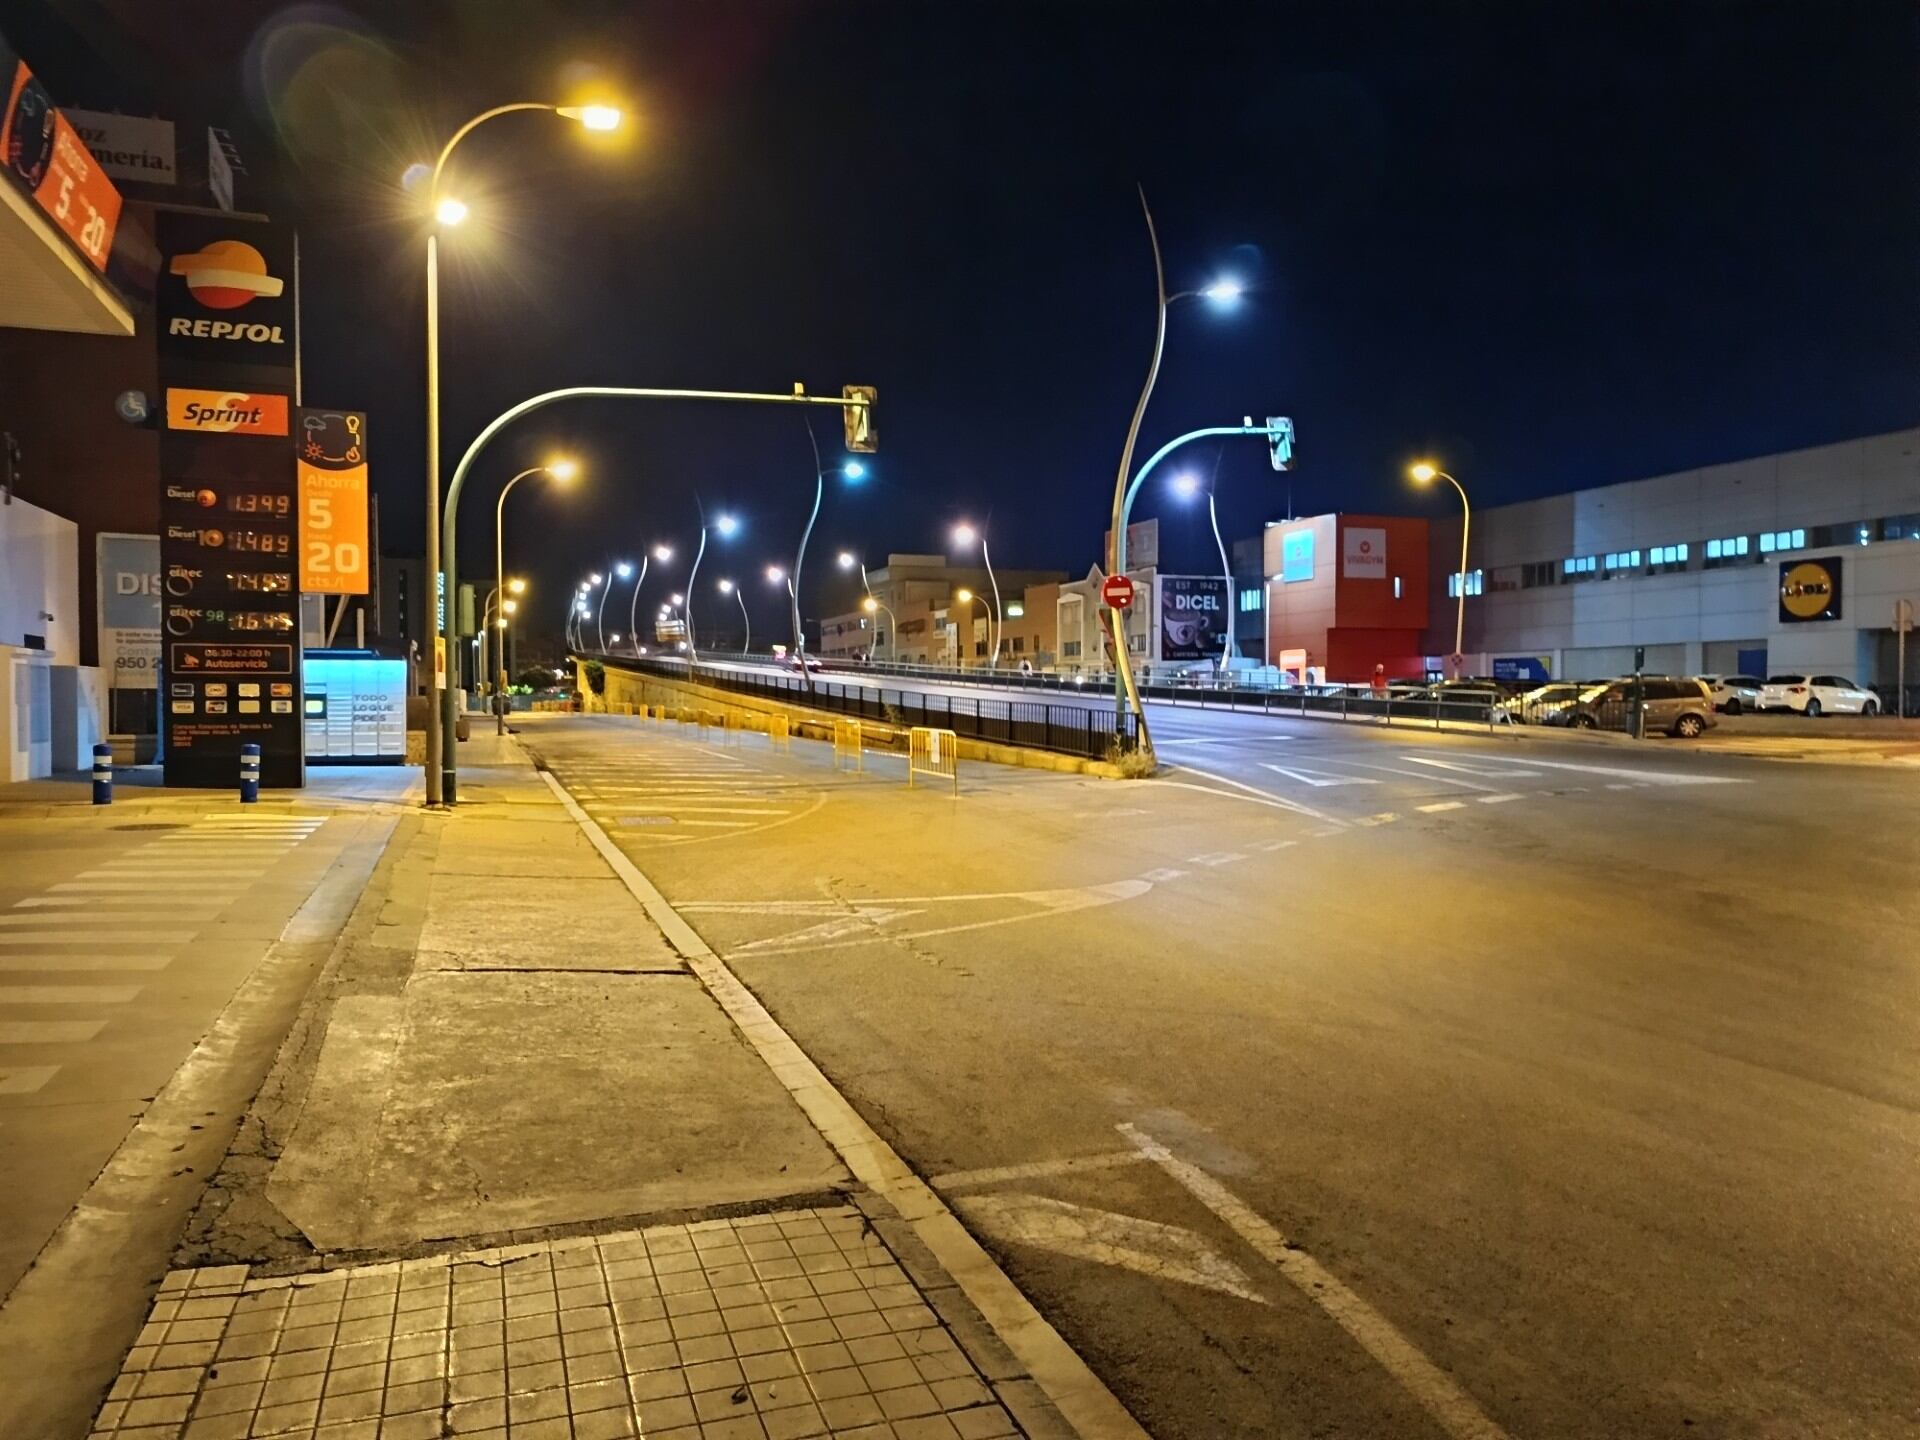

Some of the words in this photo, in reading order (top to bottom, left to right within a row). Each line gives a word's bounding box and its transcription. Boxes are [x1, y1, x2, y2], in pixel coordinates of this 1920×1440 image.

[55, 175, 75, 219] 5
[80, 205, 106, 256] 20
[169, 318, 285, 344] REPSOL
[183, 402, 263, 426] Sprint
[306, 474, 361, 490] Ahorra
[167, 489, 196, 499] Diesel
[307, 498, 333, 529] 5
[168, 528, 197, 538] Diesel
[307, 541, 361, 574] 20
[1175, 594, 1220, 610] DICEL
[206, 609, 225, 622] 98
[116, 656, 147, 669] 950
[205, 660, 268, 669] Autoservicio
